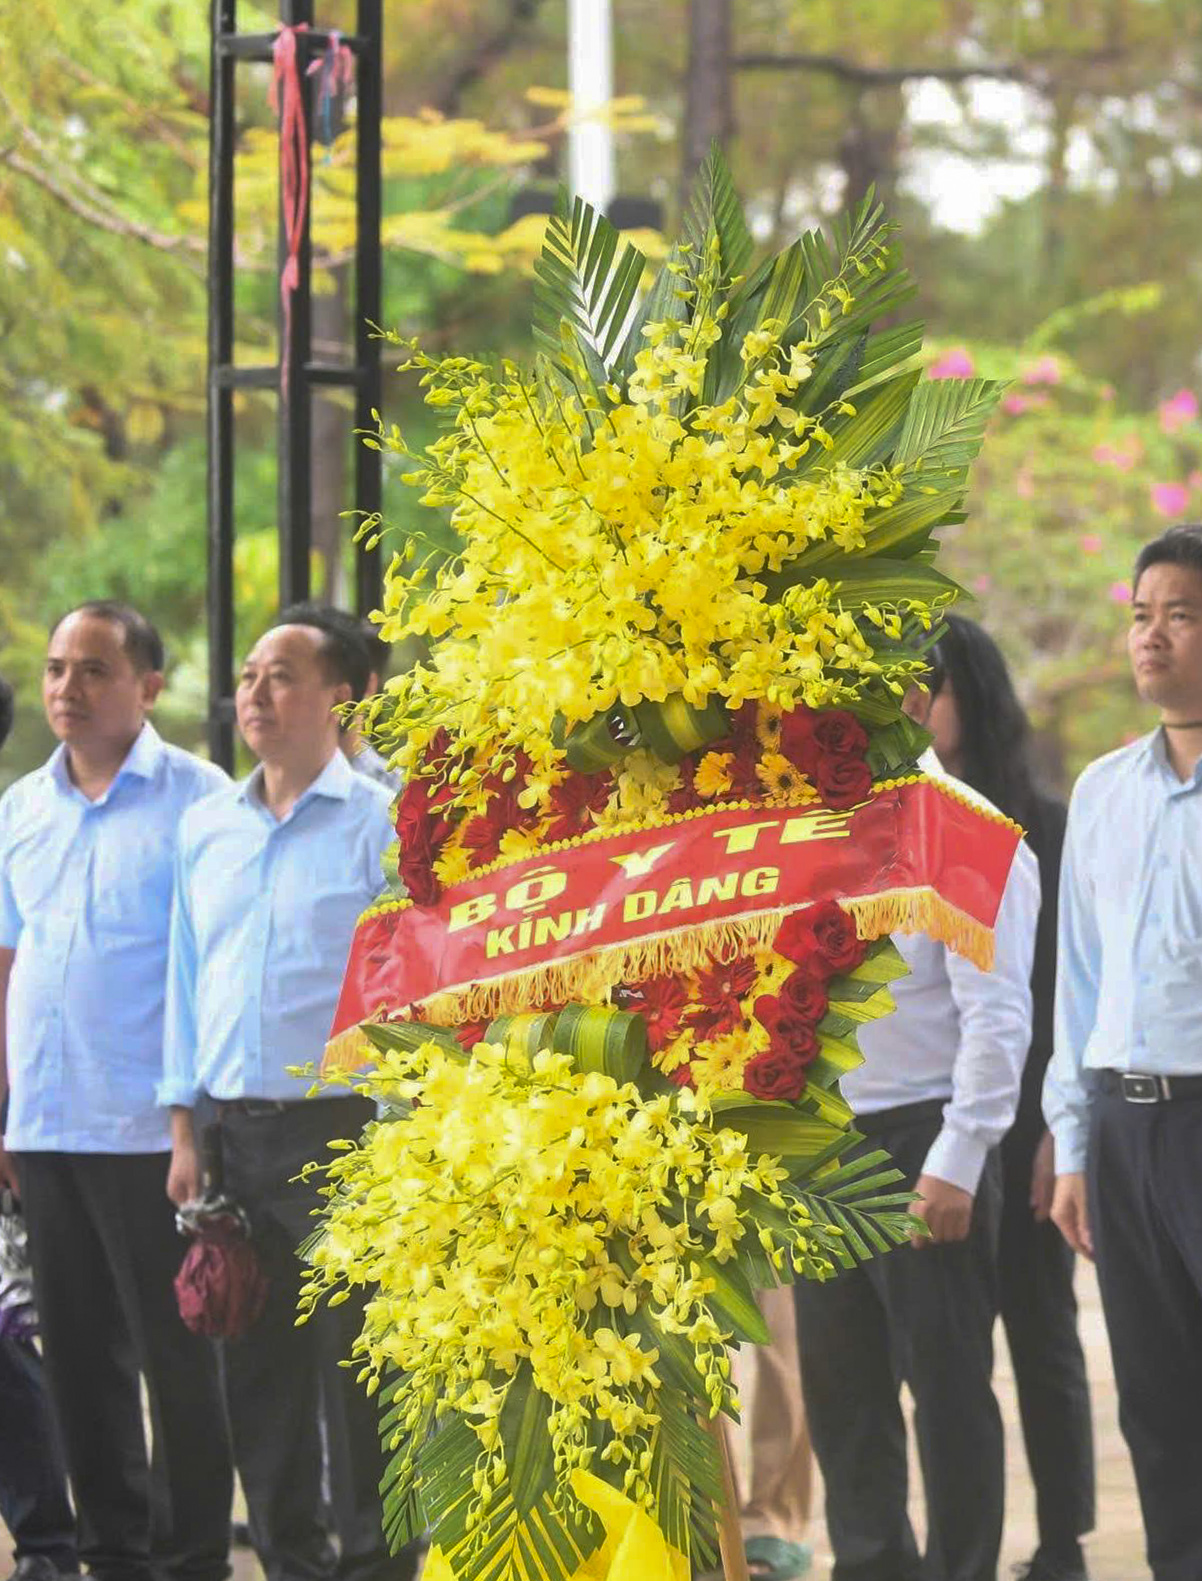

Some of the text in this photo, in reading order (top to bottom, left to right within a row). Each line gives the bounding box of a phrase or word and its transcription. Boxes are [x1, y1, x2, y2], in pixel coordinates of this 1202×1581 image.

[448, 798, 873, 933] BỘ Y TẾ
[486, 867, 780, 959] KÍNH DÂNG
